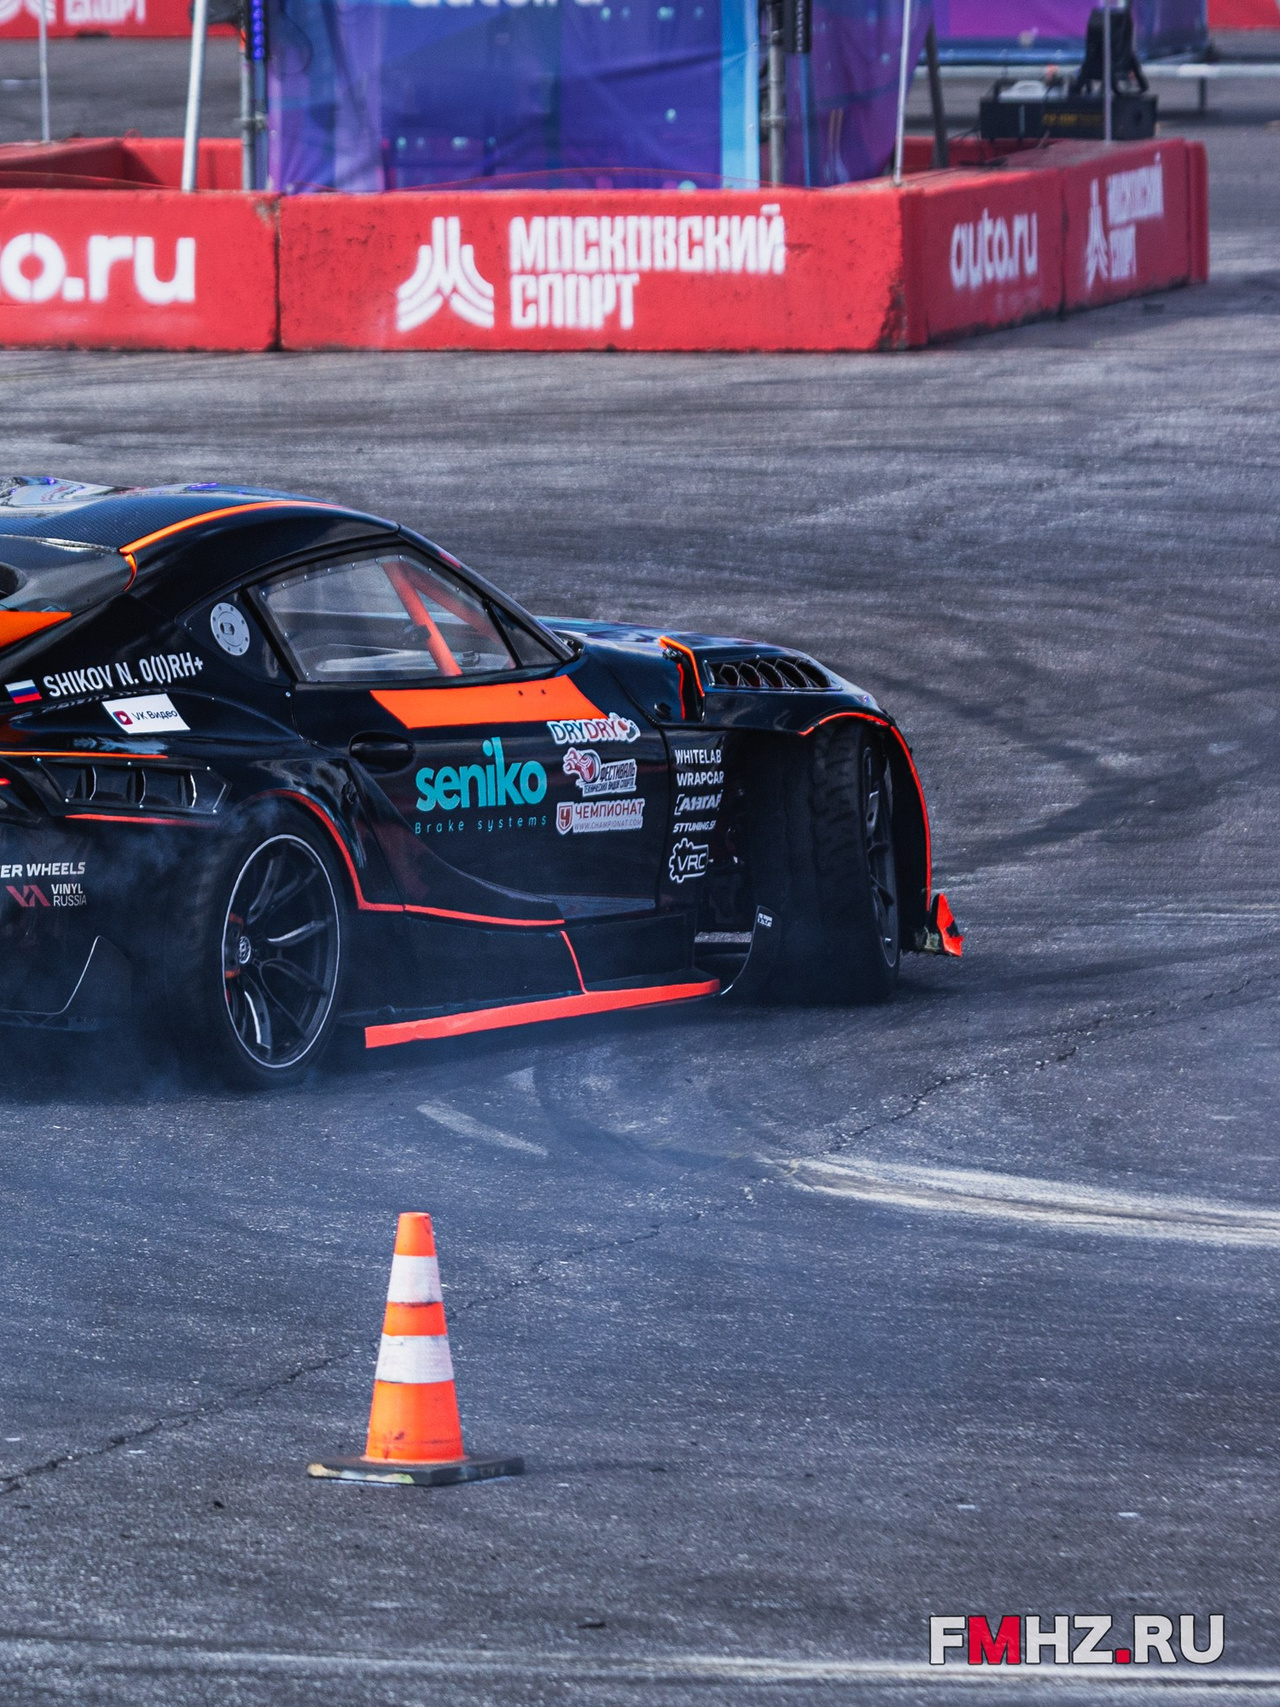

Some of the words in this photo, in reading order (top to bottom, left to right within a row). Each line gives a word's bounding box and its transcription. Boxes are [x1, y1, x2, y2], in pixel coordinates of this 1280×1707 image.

[509, 203, 786, 274] МОСКОВСКИЙ
[950, 207, 1038, 291] auto.ru
[510, 272, 640, 330] СПОРТ
[42, 664, 113, 698] SHIKOV
[115, 661, 140, 686] N.
[131, 711, 148, 721] VK
[146, 709, 178, 720] Видео
[548, 720, 618, 744] DRYDRY
[674, 749, 722, 764] WHITELAB
[415, 736, 548, 812] seniko
[676, 770, 725, 787] WRAPCAR
[575, 801, 644, 819] ЧЕМПИОНАТ
[477, 815, 548, 833] systems
[26, 861, 87, 877] WHEELS
[677, 853, 708, 872] VRC
[50, 883, 84, 895] VINYL
[53, 894, 87, 907] RUSSIA
